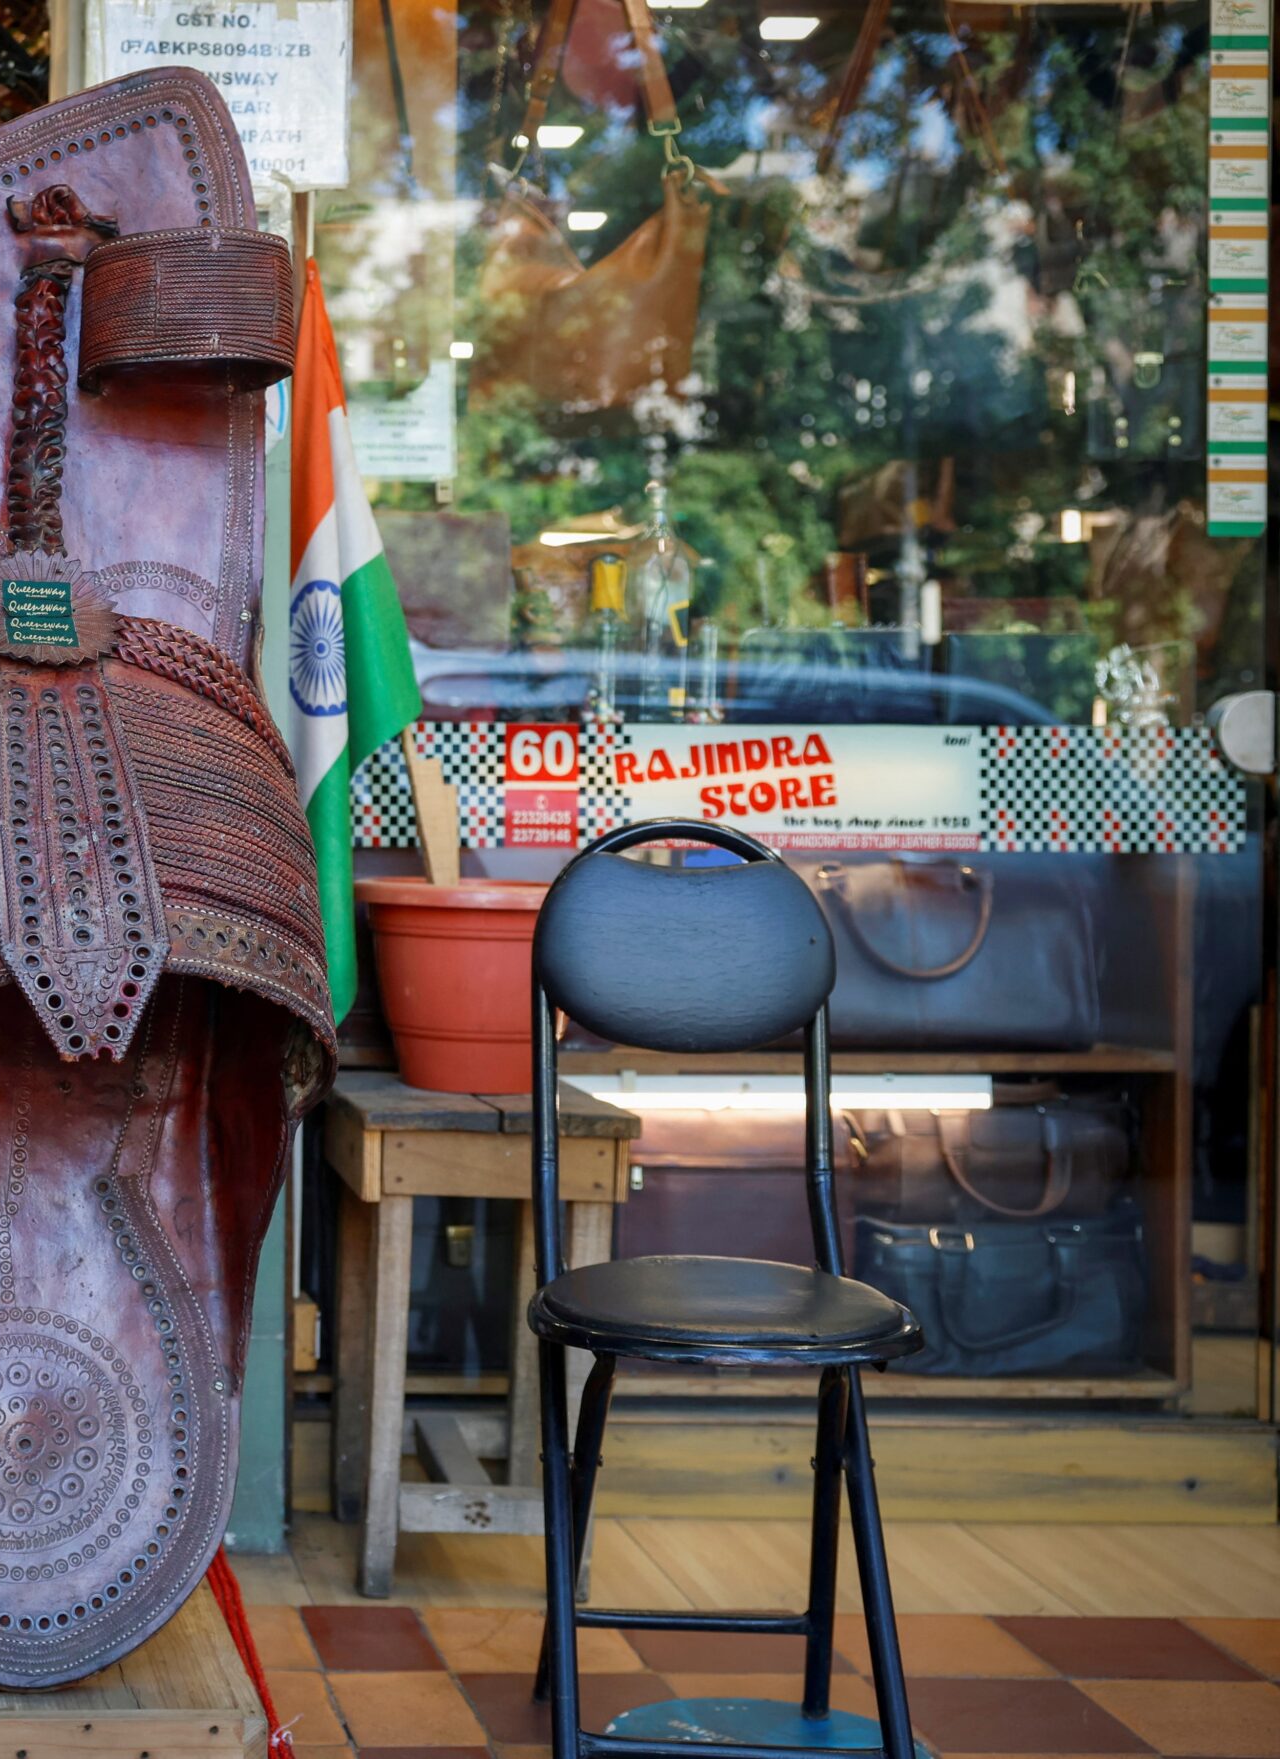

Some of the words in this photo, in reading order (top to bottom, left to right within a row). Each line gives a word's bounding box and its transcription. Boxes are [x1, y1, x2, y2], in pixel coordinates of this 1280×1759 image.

[176, 13, 215, 27] GST
[222, 14, 258, 28] NO.
[206, 71, 279, 86] NSWAY
[249, 158, 306, 172] 10001
[7, 581, 66, 599] Queensway
[8, 600, 67, 614] Queensway
[10, 617, 70, 631] Queensway
[13, 631, 74, 645] Queensway
[509, 729, 576, 777] 60
[614, 733, 833, 785] RAJINDRA
[699, 773, 838, 819] STORE
[783, 815, 807, 827] the
[813, 815, 842, 830] bag
[847, 815, 882, 830] shop
[887, 814, 926, 828] since
